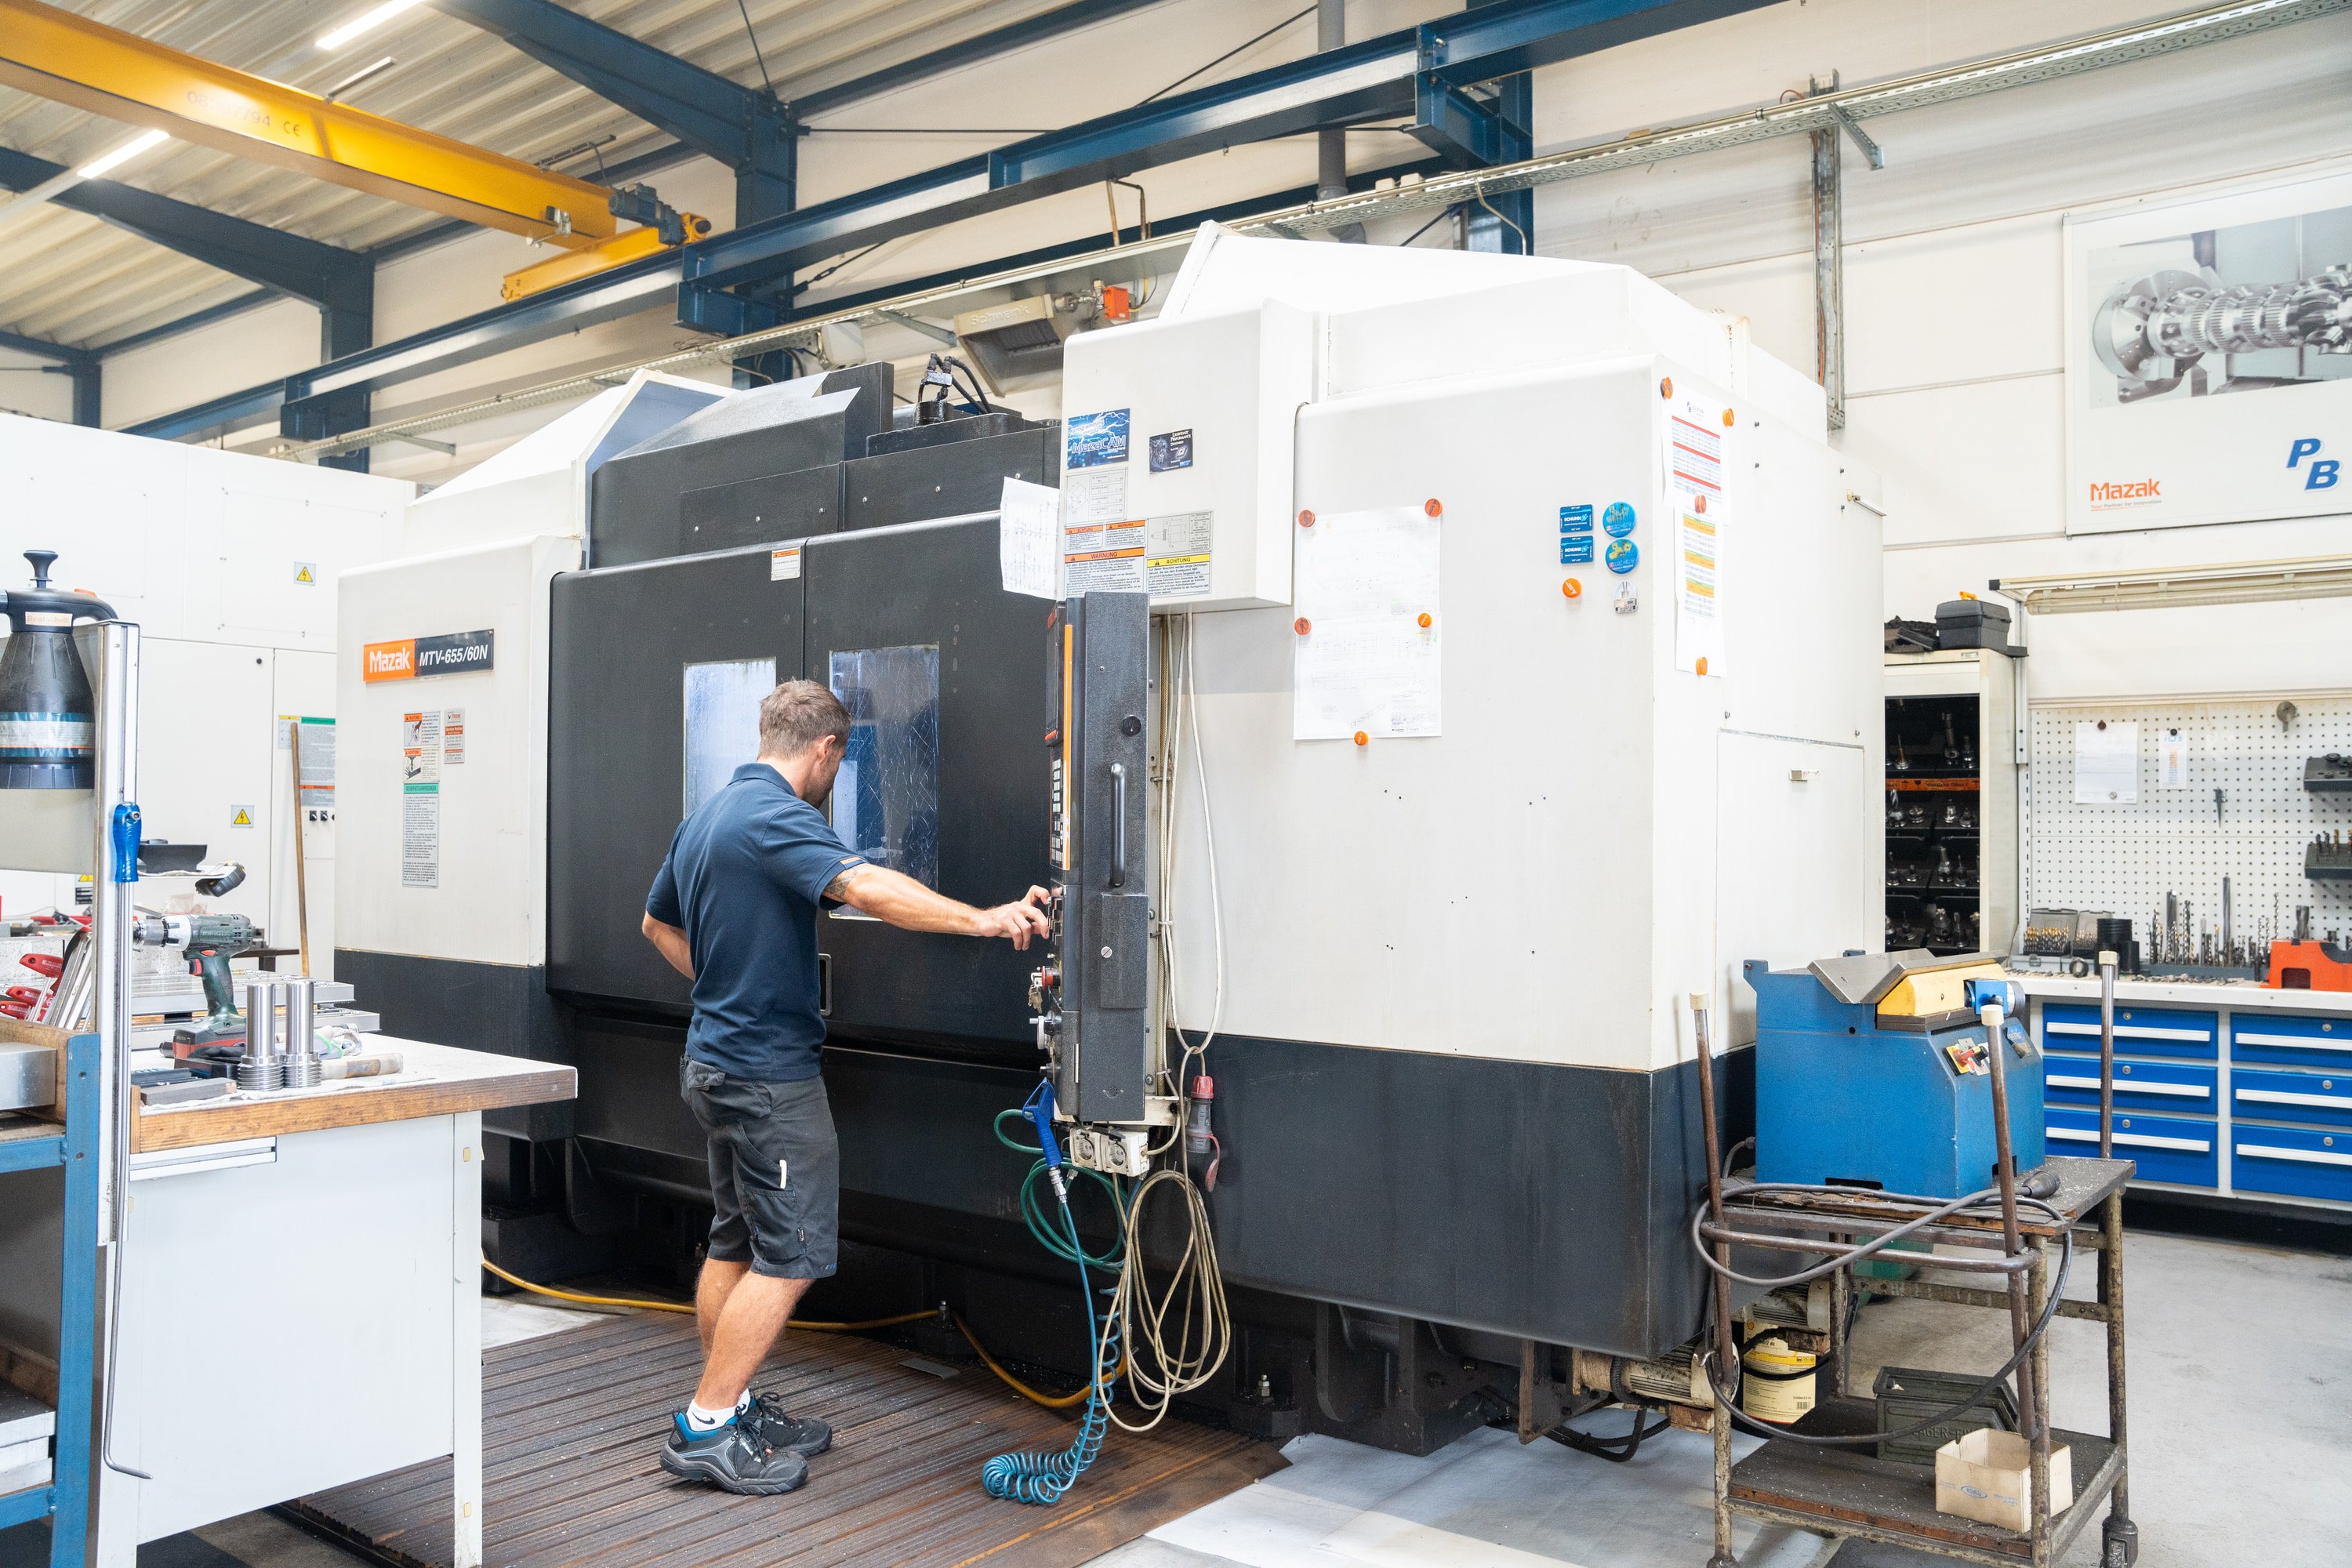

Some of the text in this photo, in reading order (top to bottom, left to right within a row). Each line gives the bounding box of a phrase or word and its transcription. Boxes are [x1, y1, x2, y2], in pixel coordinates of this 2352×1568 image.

[970, 304, 1029, 326] Schwank
[1072, 435, 1127, 453] MazaCAM
[2090, 477, 2161, 502] Mazak
[369, 644, 488, 673] Mazak MTV-655/60N
